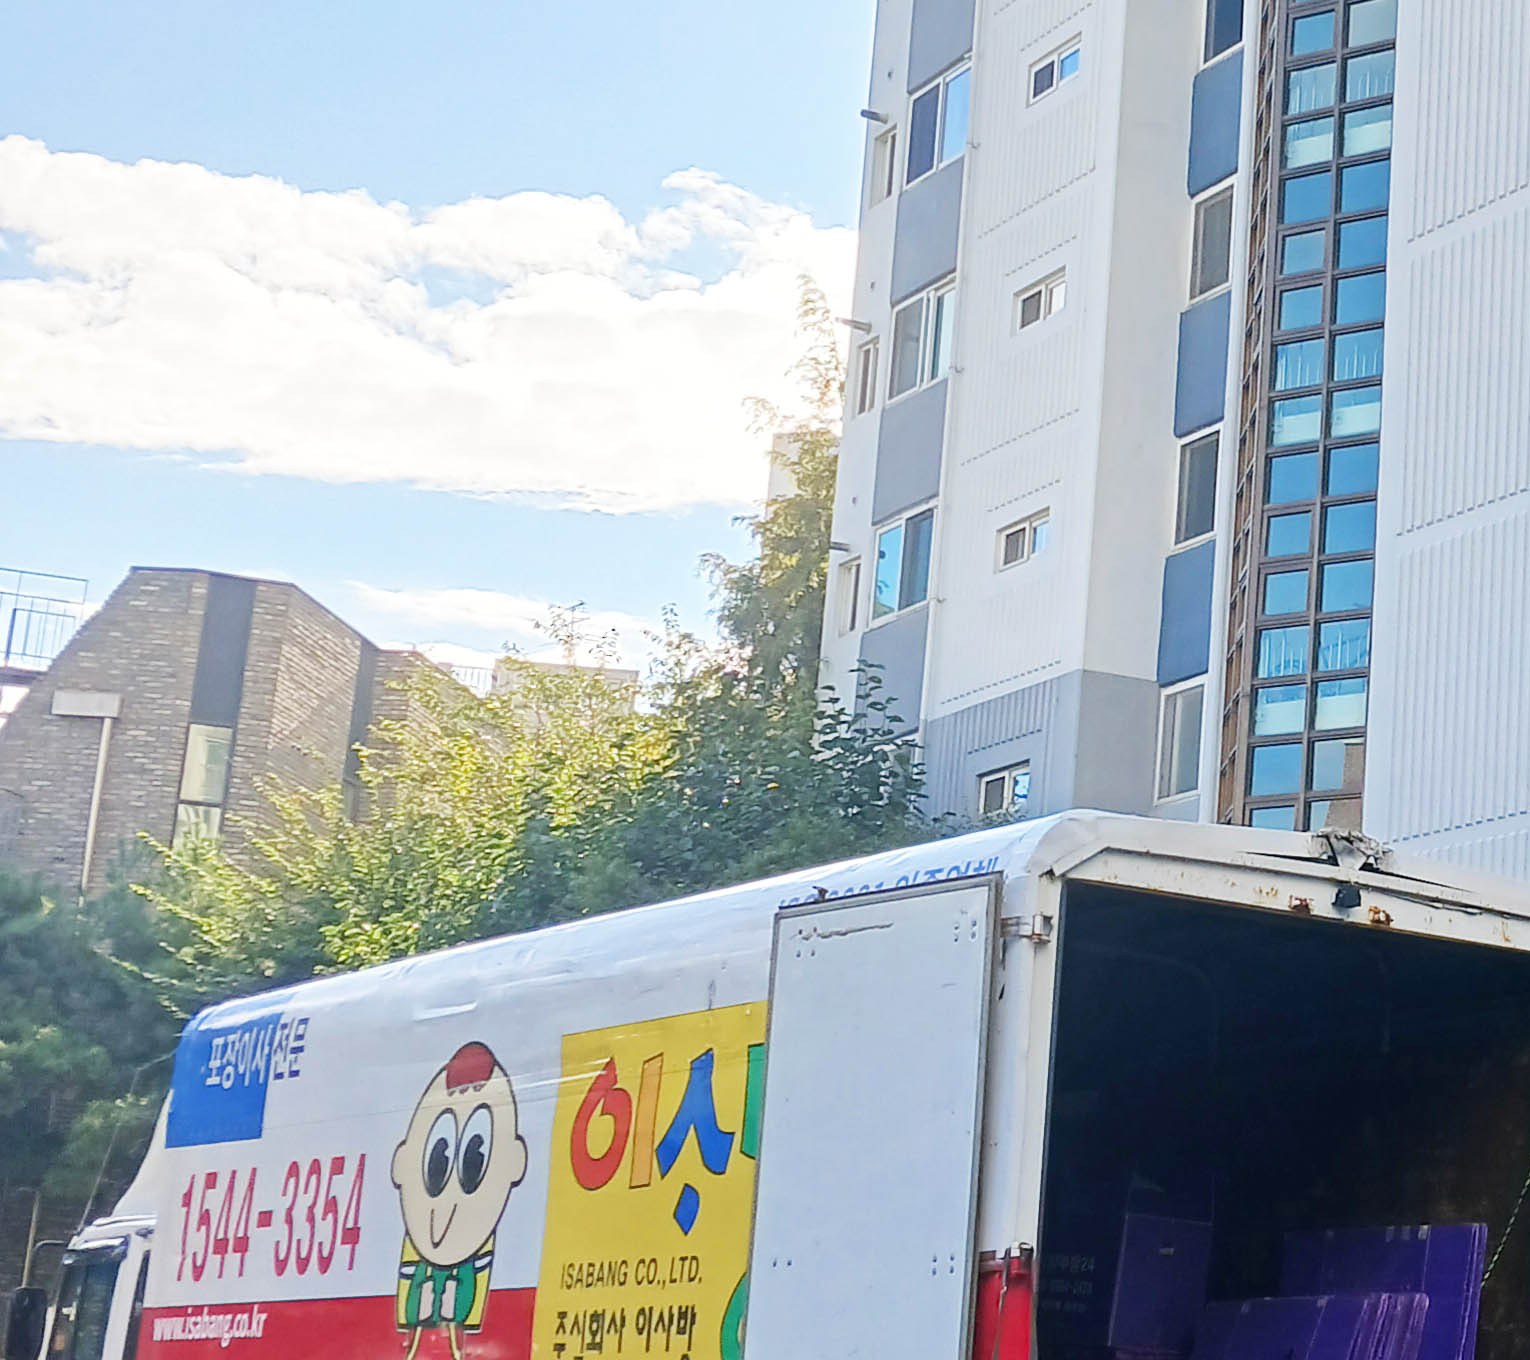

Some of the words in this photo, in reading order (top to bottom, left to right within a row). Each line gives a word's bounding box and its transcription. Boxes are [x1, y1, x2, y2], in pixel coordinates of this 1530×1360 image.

[177, 1153, 367, 1282] 1544-3354
[561, 1259, 628, 1290] ISABANG
[153, 1304, 268, 1348] www.isabang.co.kr
